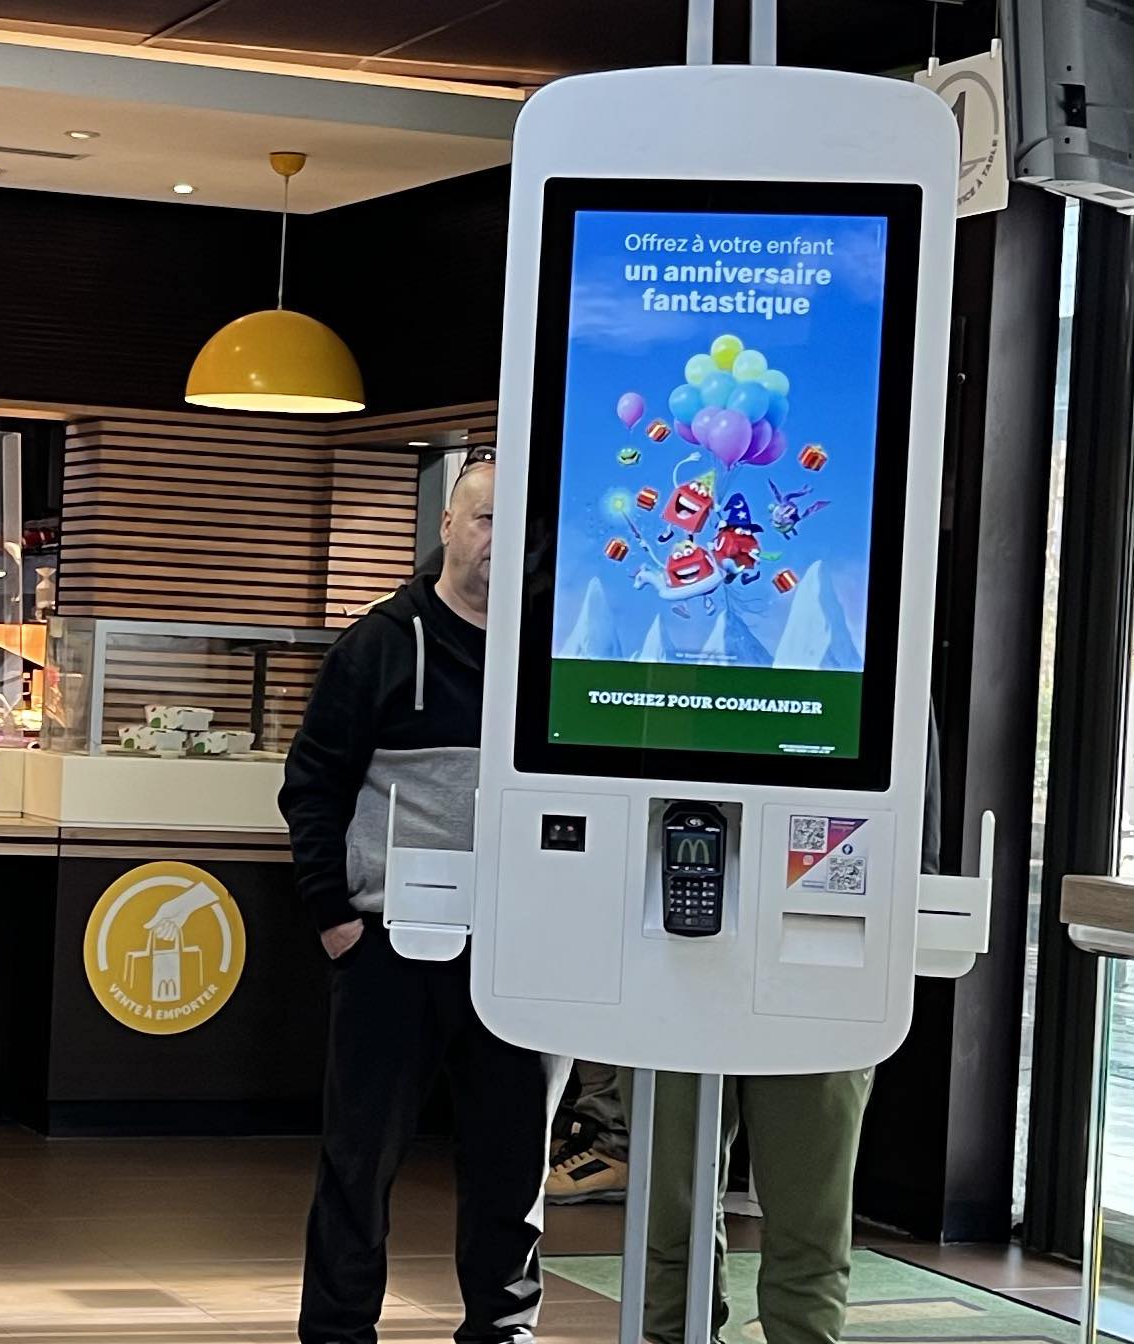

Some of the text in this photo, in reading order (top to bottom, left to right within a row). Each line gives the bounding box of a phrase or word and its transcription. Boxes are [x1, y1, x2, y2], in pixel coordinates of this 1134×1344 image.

[982, 139, 999, 177] TABLE
[624, 233, 835, 256] Offrez à votre enfant
[624, 259, 832, 286] un anniversaire
[642, 287, 811, 321] fantastique
[588, 690, 823, 715] TOUCHEZ POUR COMMANDER
[109, 983, 219, 1020] VENTE À EMPORTER
